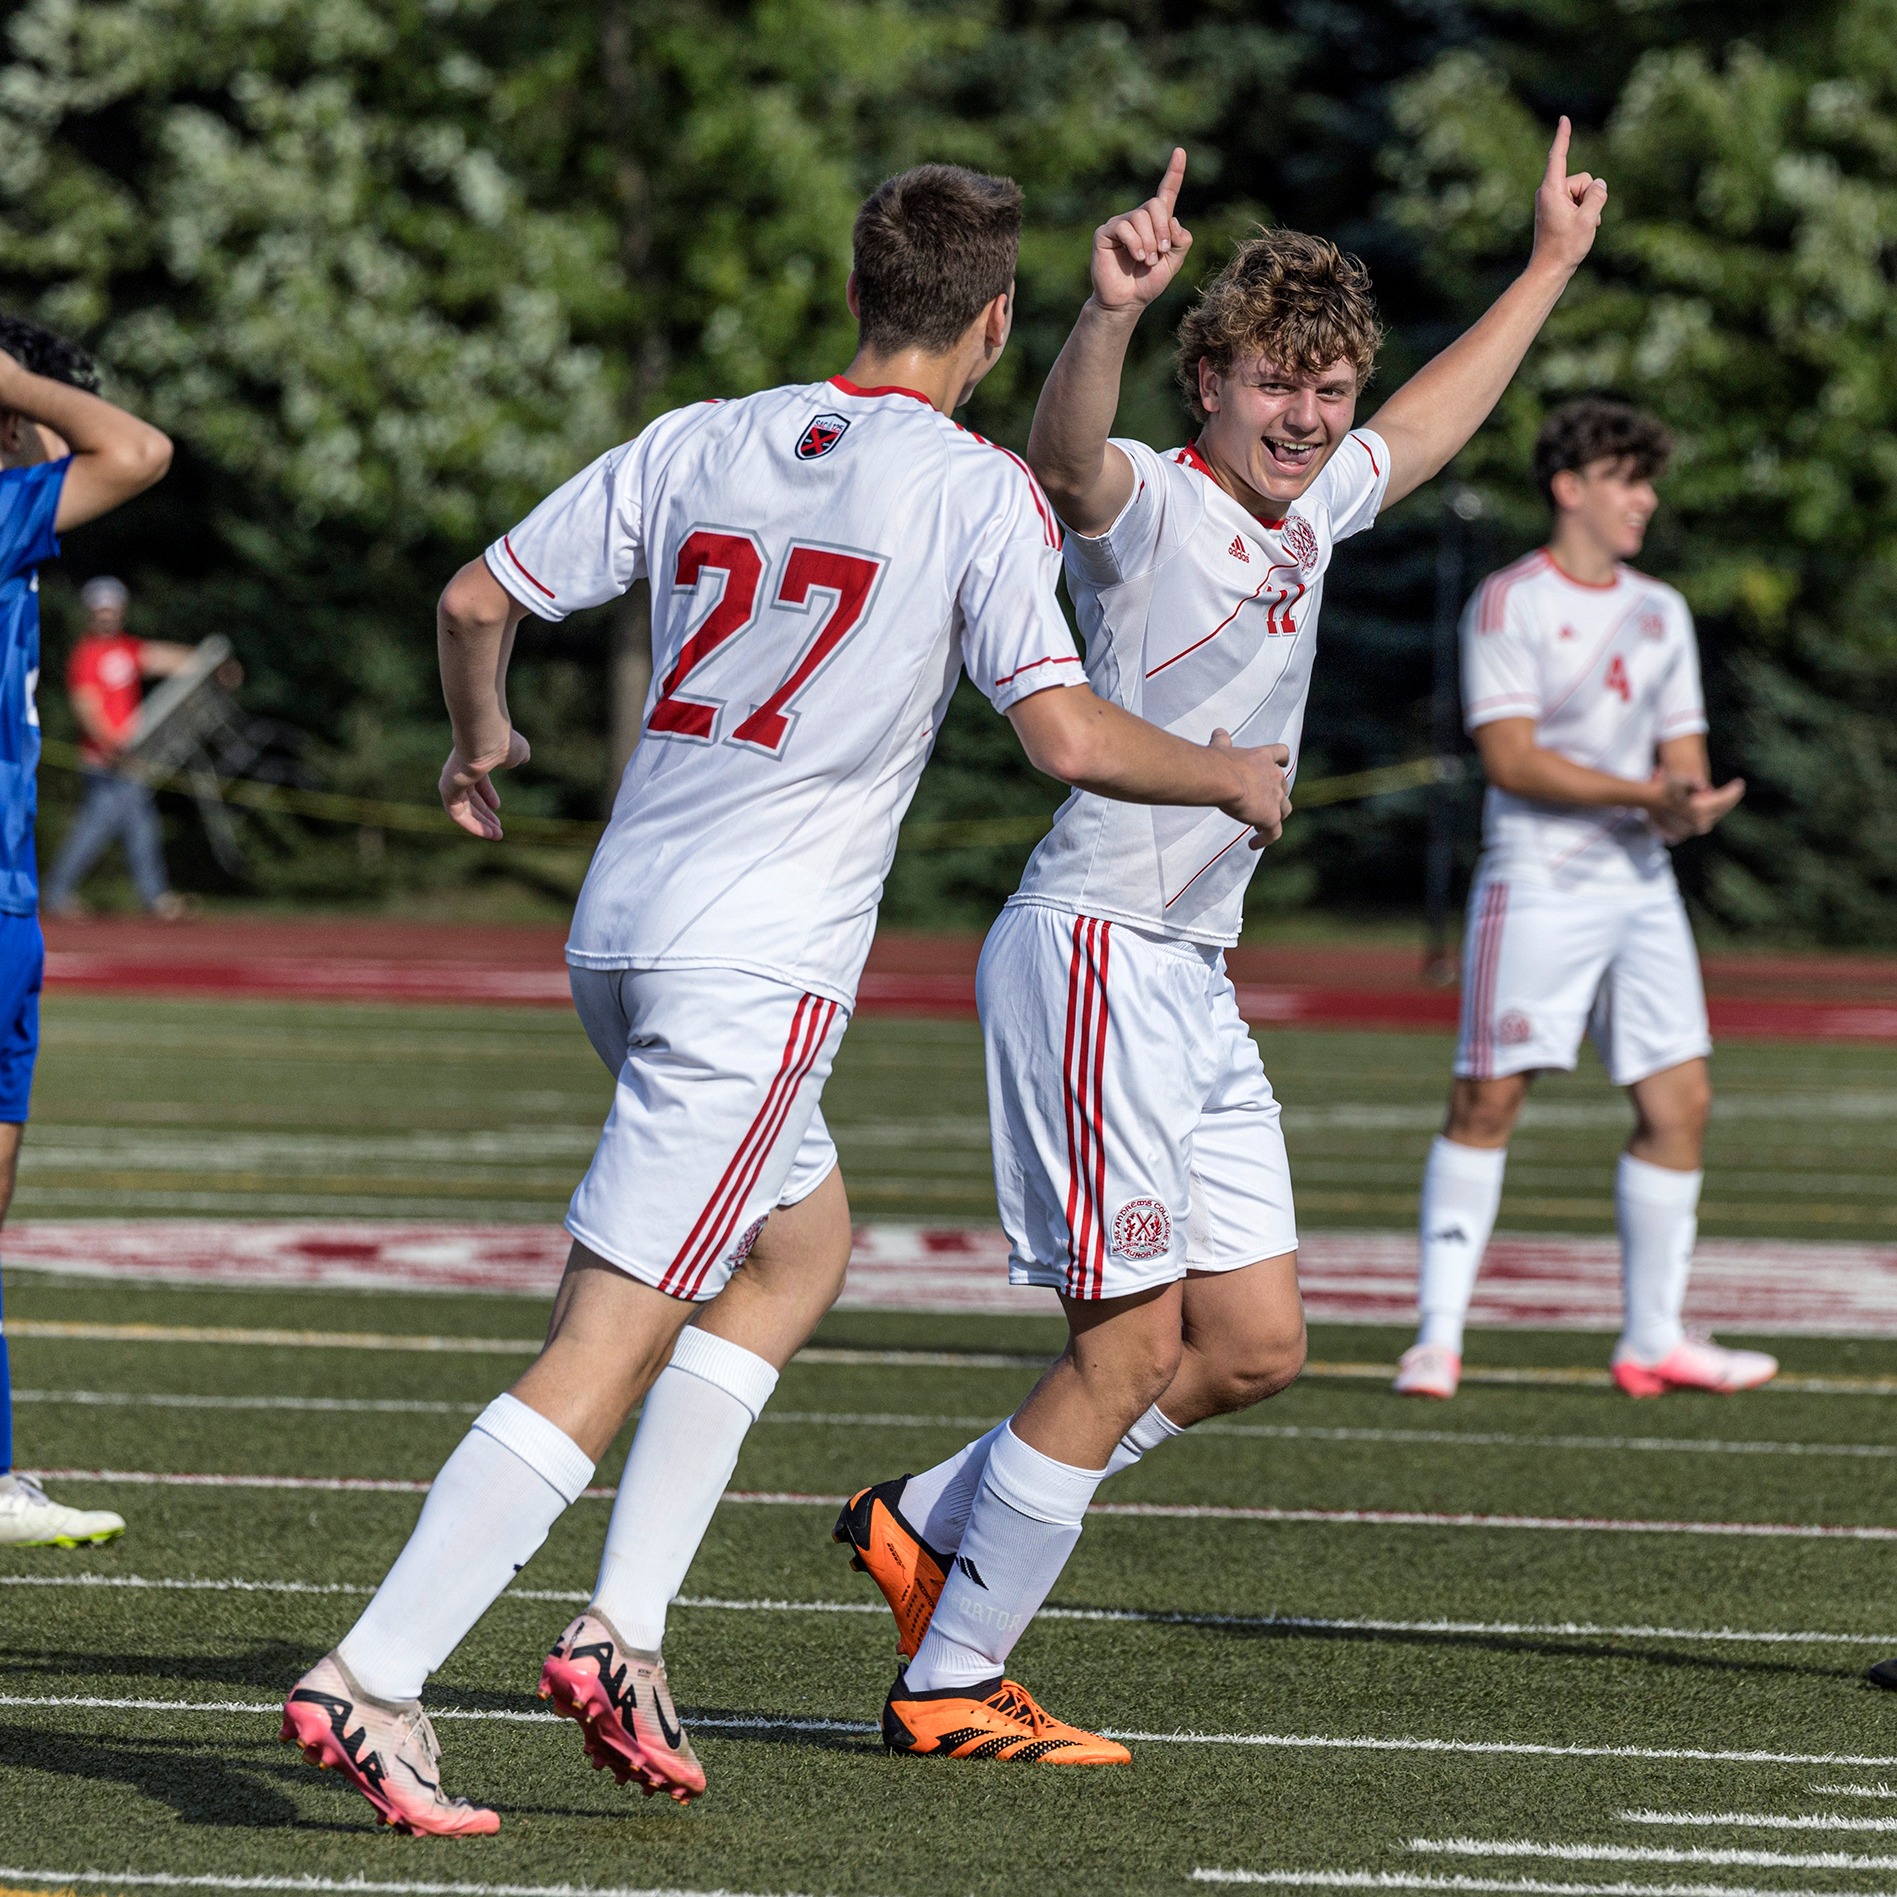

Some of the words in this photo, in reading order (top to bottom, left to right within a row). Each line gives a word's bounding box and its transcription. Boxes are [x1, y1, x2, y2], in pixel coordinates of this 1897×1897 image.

[1228, 547, 1249, 563] adidas
[645, 522, 891, 761] 27
[1603, 655, 1631, 703] 4
[1153, 1202, 1170, 1241] COLLEGE
[1124, 1249, 1158, 1258] AURORA
